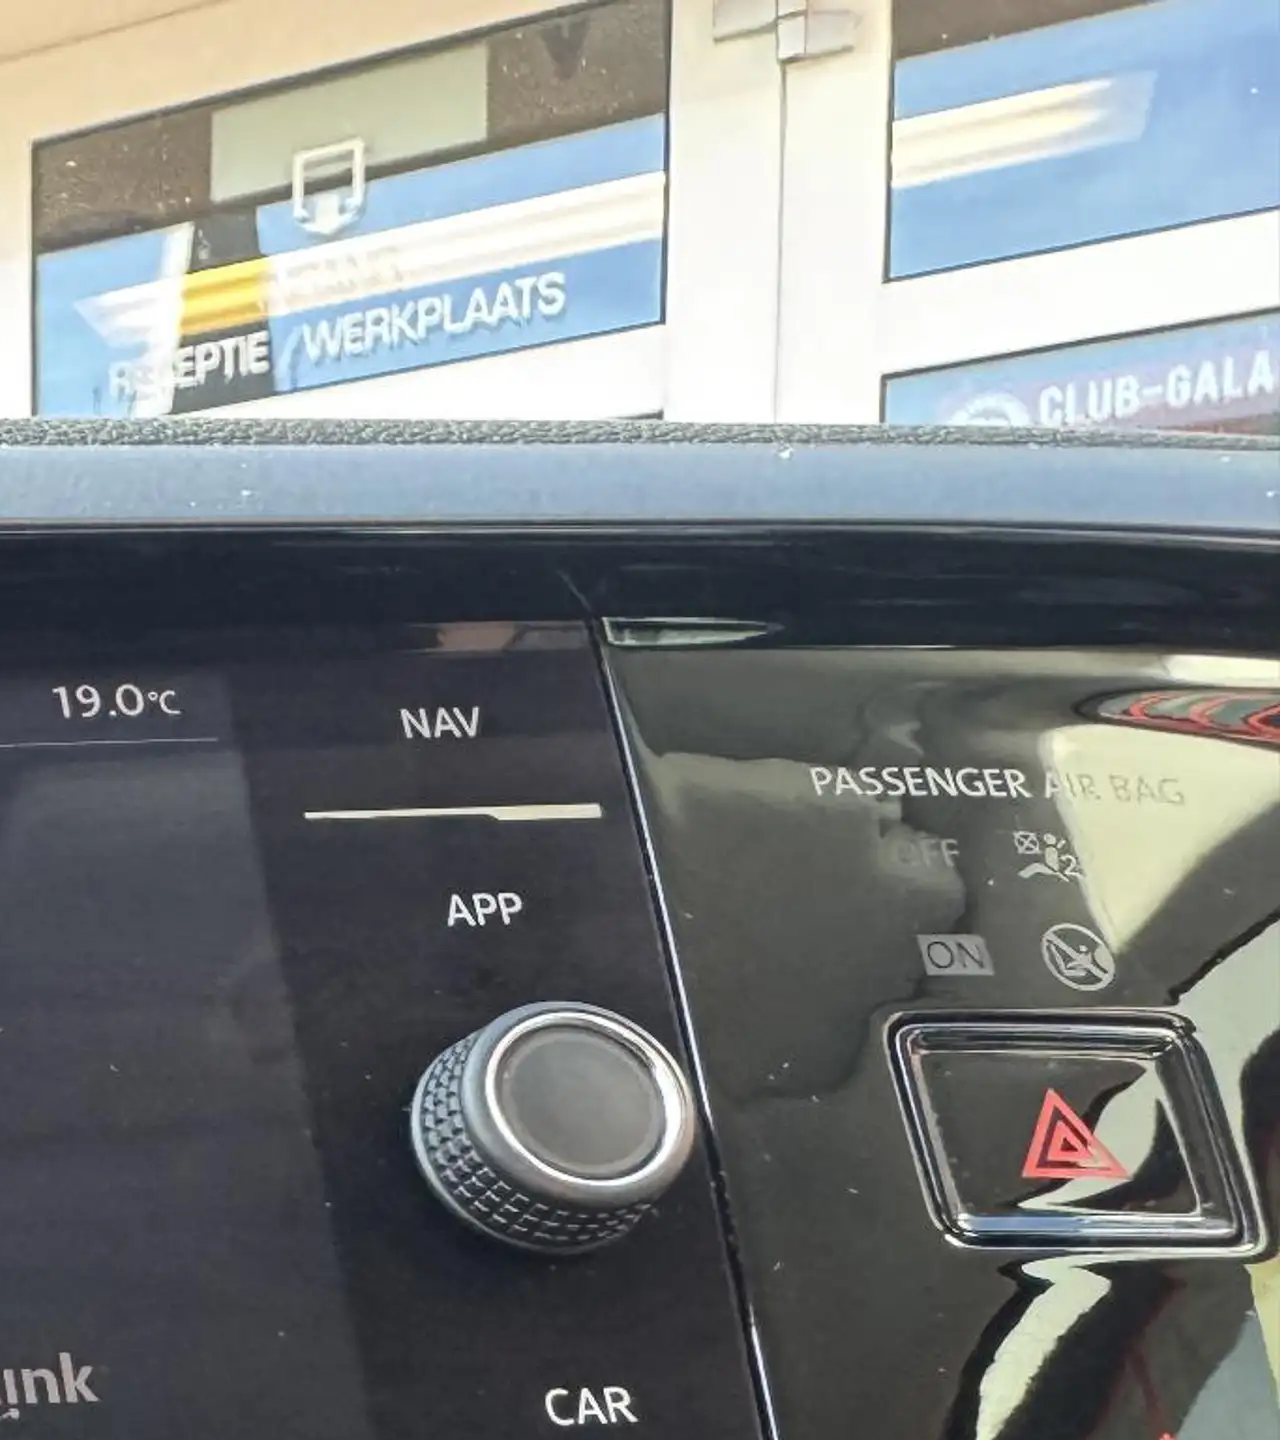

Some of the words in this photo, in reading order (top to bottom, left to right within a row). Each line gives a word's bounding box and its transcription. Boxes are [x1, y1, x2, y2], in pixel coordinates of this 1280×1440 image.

[302, 271, 568, 361] WERKPLAATS
[400, 706, 479, 739] NAV
[809, 765, 1032, 799] PASSENGER
[1044, 768, 1096, 800] AIR
[1113, 773, 1185, 806] BAG
[447, 892, 523, 927] APP
[925, 940, 987, 970] ON
[544, 1386, 638, 1427] CAR
